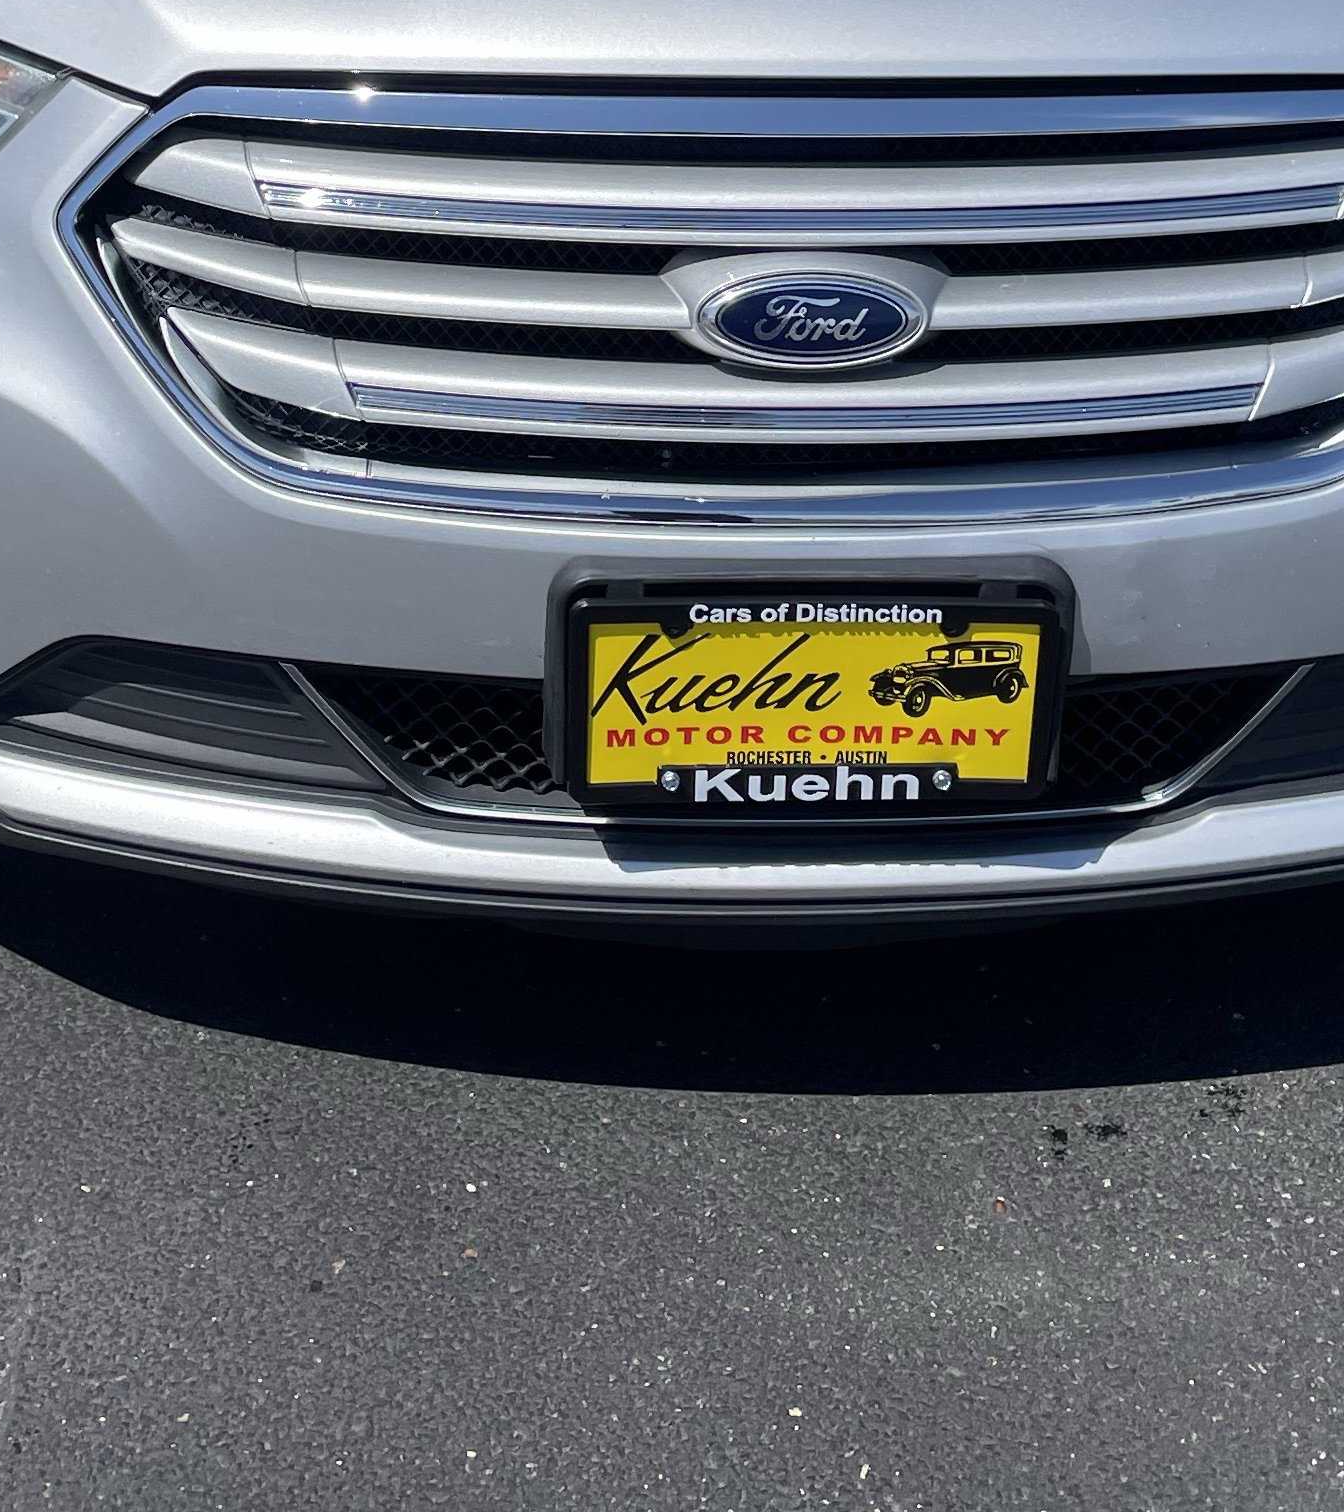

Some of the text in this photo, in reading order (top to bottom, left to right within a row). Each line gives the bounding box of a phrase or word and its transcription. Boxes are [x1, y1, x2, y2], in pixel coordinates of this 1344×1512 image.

[754, 294, 867, 342] Ford
[689, 603, 943, 624] Cars of Distinction
[590, 632, 842, 726] Kuehn
[605, 724, 1012, 748] MOTOR COMPANY
[726, 750, 888, 767] ROCHESTER AUSTIN
[693, 765, 920, 803] Kuehn
